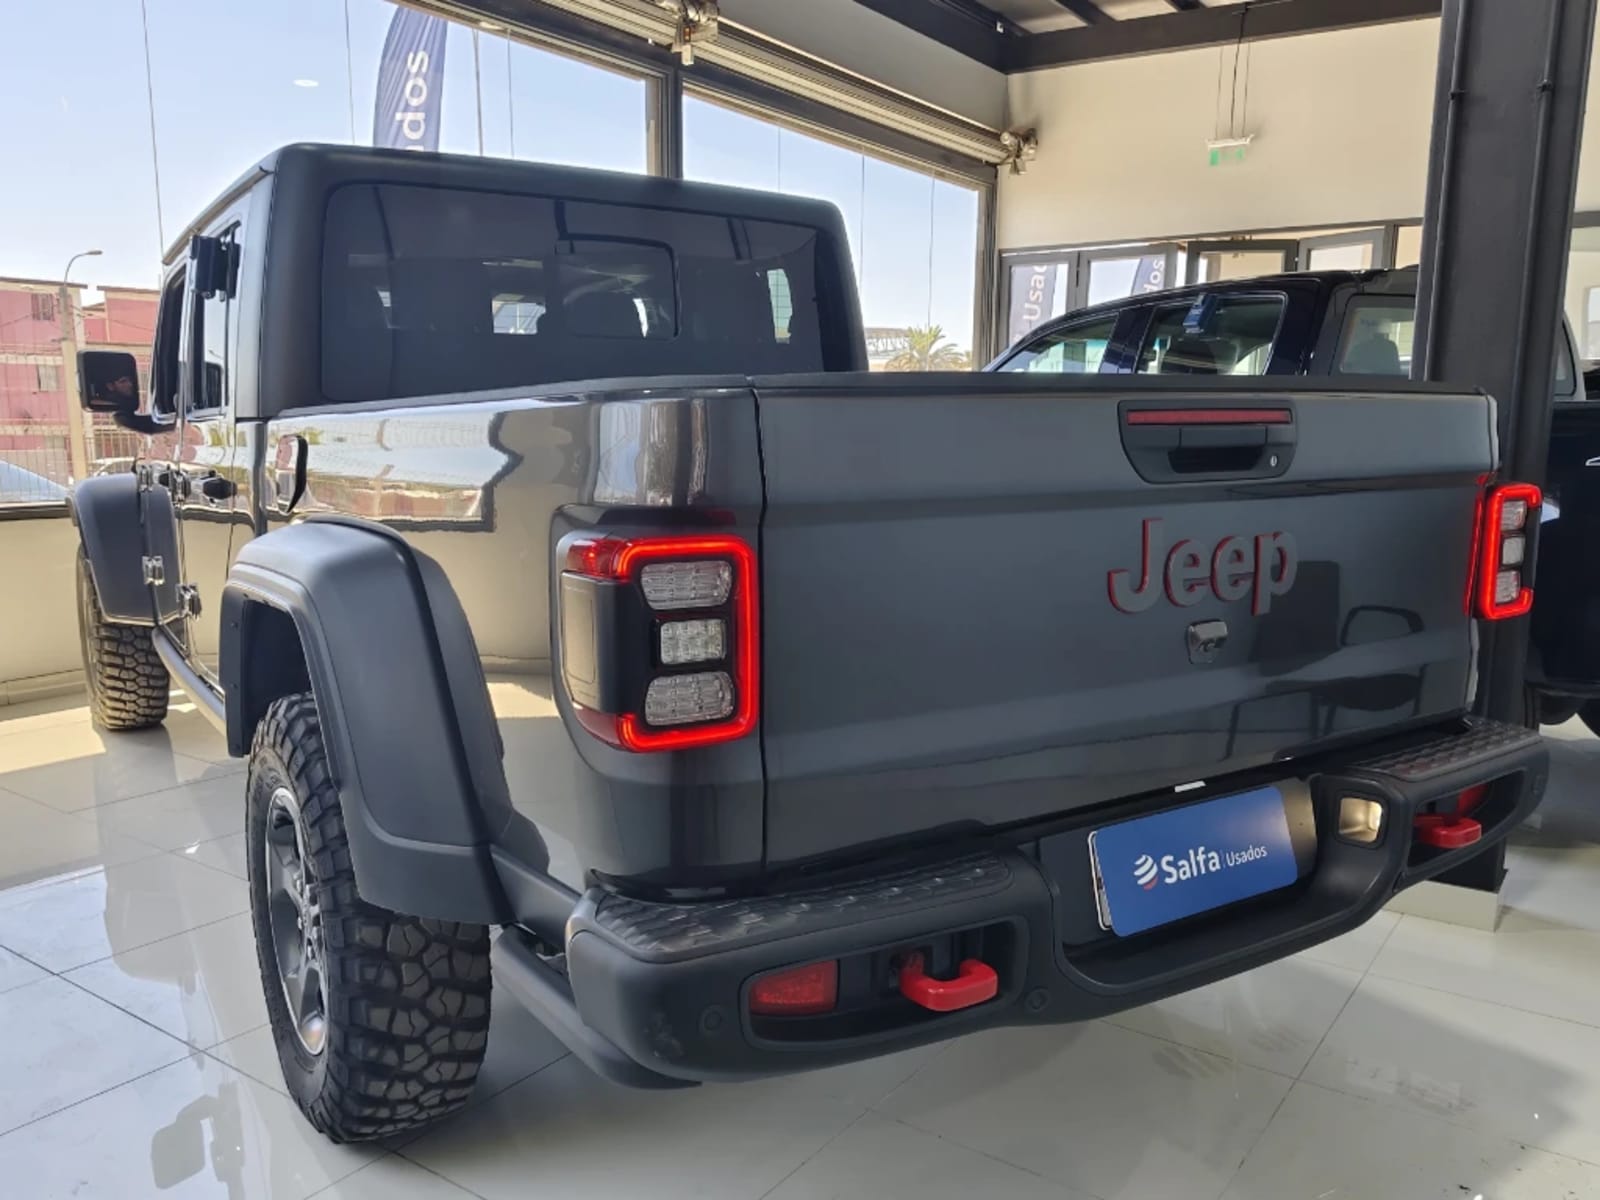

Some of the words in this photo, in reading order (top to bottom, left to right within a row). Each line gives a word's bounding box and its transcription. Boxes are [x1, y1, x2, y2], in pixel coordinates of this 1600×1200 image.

[395, 51, 429, 151] dos
[1107, 517, 1298, 616] Jeep
[1161, 846, 1221, 884] Salfa
[1227, 845, 1268, 868] Usados
